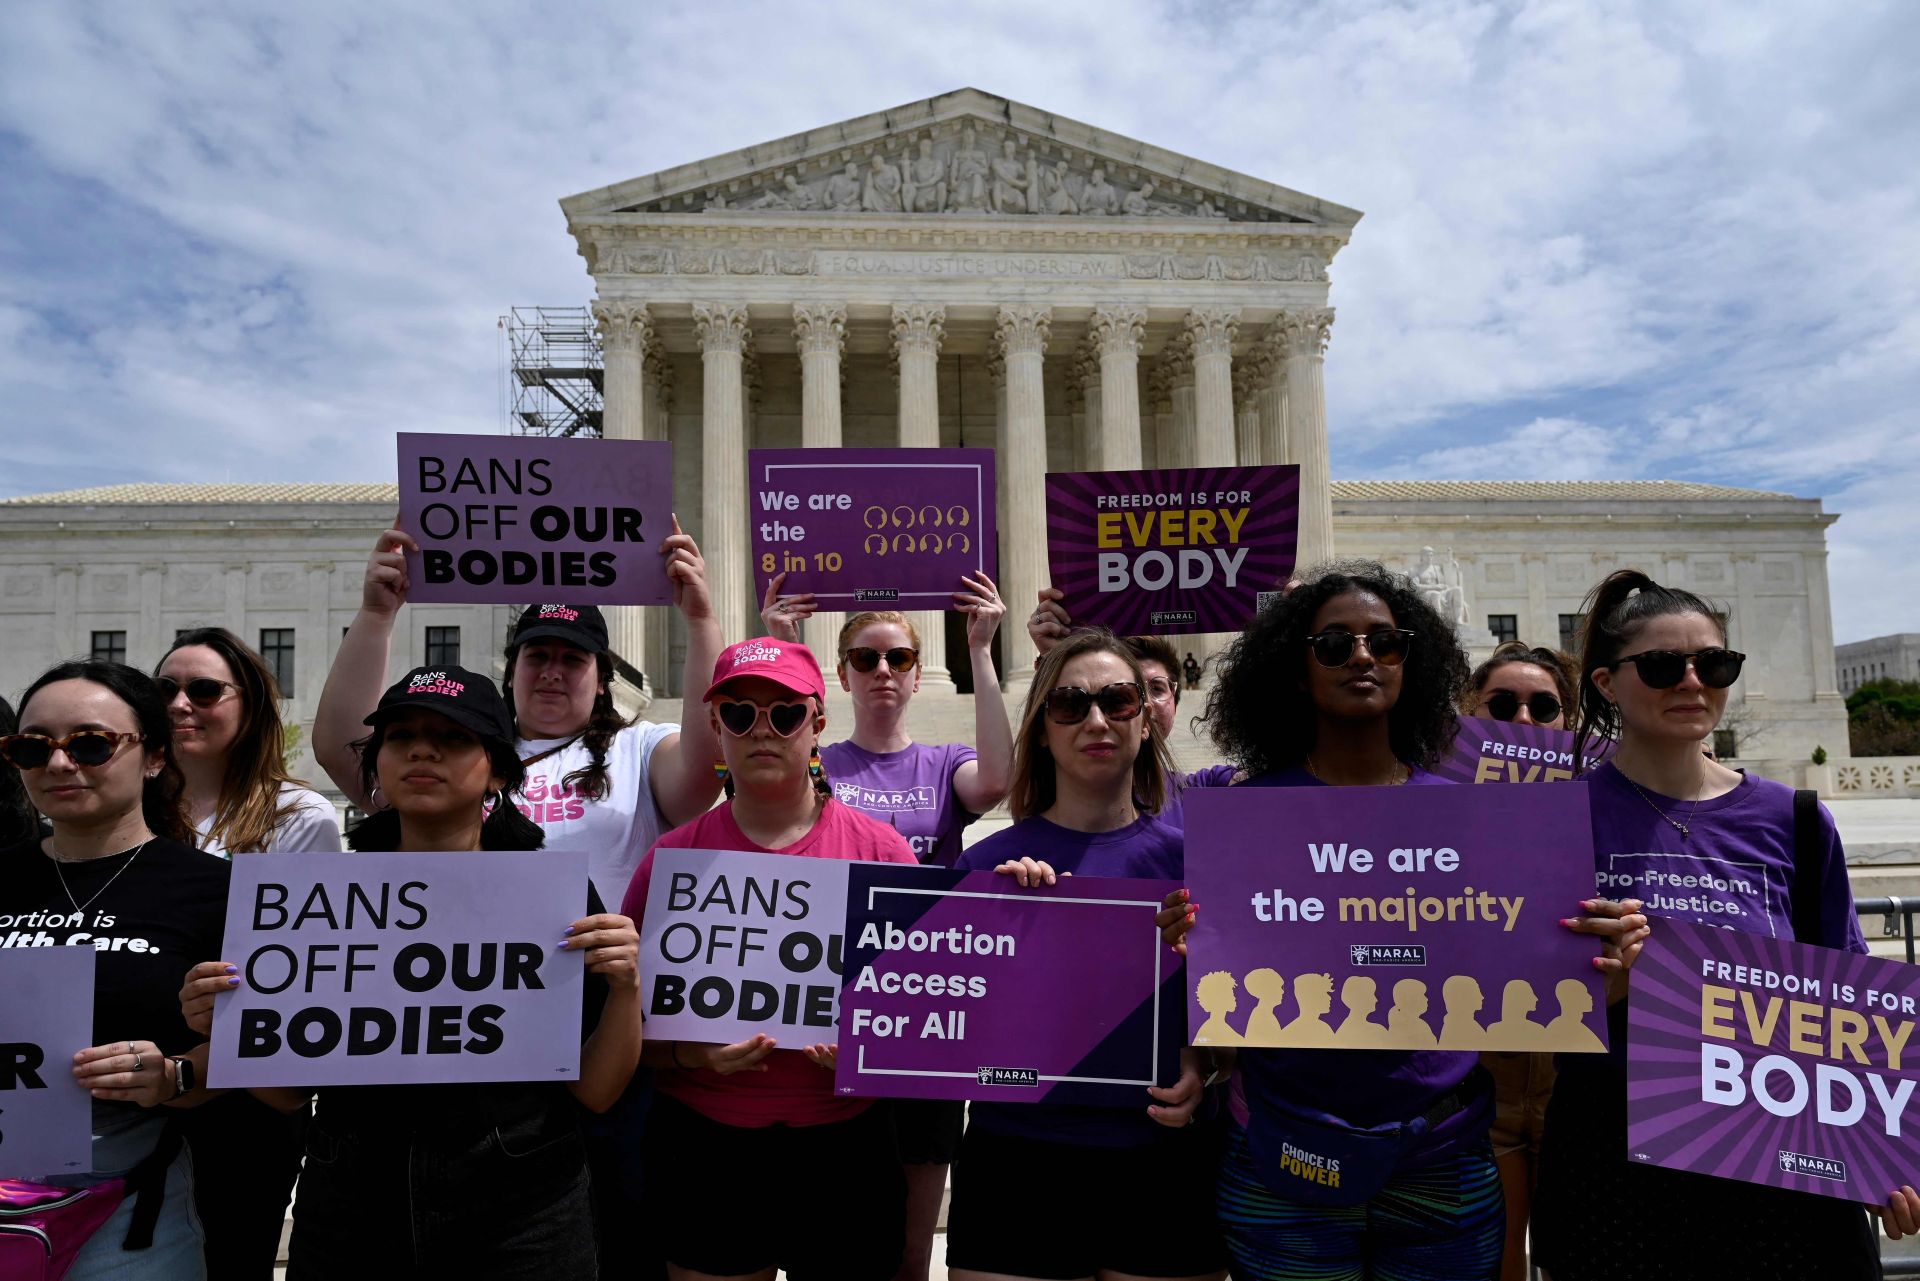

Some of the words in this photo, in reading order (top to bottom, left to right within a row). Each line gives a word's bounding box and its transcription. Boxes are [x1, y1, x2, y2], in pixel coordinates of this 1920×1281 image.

[905, 256, 985, 274] JUSTICE
[994, 256, 1063, 274] UNDER
[1069, 258, 1108, 275] LAW
[419, 457, 552, 496] BANS
[760, 491, 800, 511] We
[808, 494, 852, 510] are
[1097, 493, 1182, 508] FREEDOM
[1191, 492, 1207, 505] IS
[1215, 490, 1251, 504] FOR
[420, 503, 518, 540] OFF
[530, 505, 645, 543] OUR
[760, 520, 805, 542] the
[1097, 507, 1250, 549] EVERY
[423, 550, 617, 587] BODIES
[762, 553, 775, 573] 8
[784, 550, 806, 572] in
[814, 552, 842, 572] 10
[1098, 547, 1250, 593] BODY
[539, 612, 575, 621] BODIES
[558, 607, 579, 617] OUR
[1164, 612, 1193, 620] NARAL
[734, 653, 777, 667] BODIES
[755, 647, 782, 656] OUR
[409, 678, 434, 687] OFF
[435, 679, 465, 693] OUR
[413, 671, 447, 681] BANS
[407, 685, 459, 697] BODIES
[1481, 740, 1574, 766] FREEDOM
[863, 790, 929, 805] NARAL
[1308, 843, 1374, 873] We
[1388, 847, 1460, 872] are
[667, 872, 812, 921] BANS
[1595, 870, 1759, 895] Pro-Freedom.
[93, 909, 117, 928] is
[252, 881, 429, 931] BANS
[1251, 889, 1325, 922] the
[1339, 887, 1525, 932] majority
[65, 932, 160, 955] Care.
[660, 922, 768, 967] OFF
[856, 921, 1016, 956] Abortion
[1372, 948, 1421, 958] NARAL
[245, 944, 379, 995] OFF
[393, 942, 546, 992] OUR
[853, 965, 987, 998] Access
[650, 974, 842, 1028] BODIE
[1702, 959, 1821, 998] FREEDOM
[1832, 983, 1856, 1004] IS
[1867, 989, 1916, 1015] FOR
[238, 1004, 506, 1058] BODIES
[852, 1008, 910, 1038] For
[920, 1010, 966, 1041] All
[1701, 983, 1916, 1071] EVERY
[995, 1070, 1035, 1080] NARAL
[1701, 1042, 1918, 1138] BODY
[1280, 1153, 1341, 1188] POWER
[1282, 1142, 1325, 1169] CHOICE
[1326, 1158, 1340, 1172] IS
[1798, 1157, 1842, 1174] NARAL
